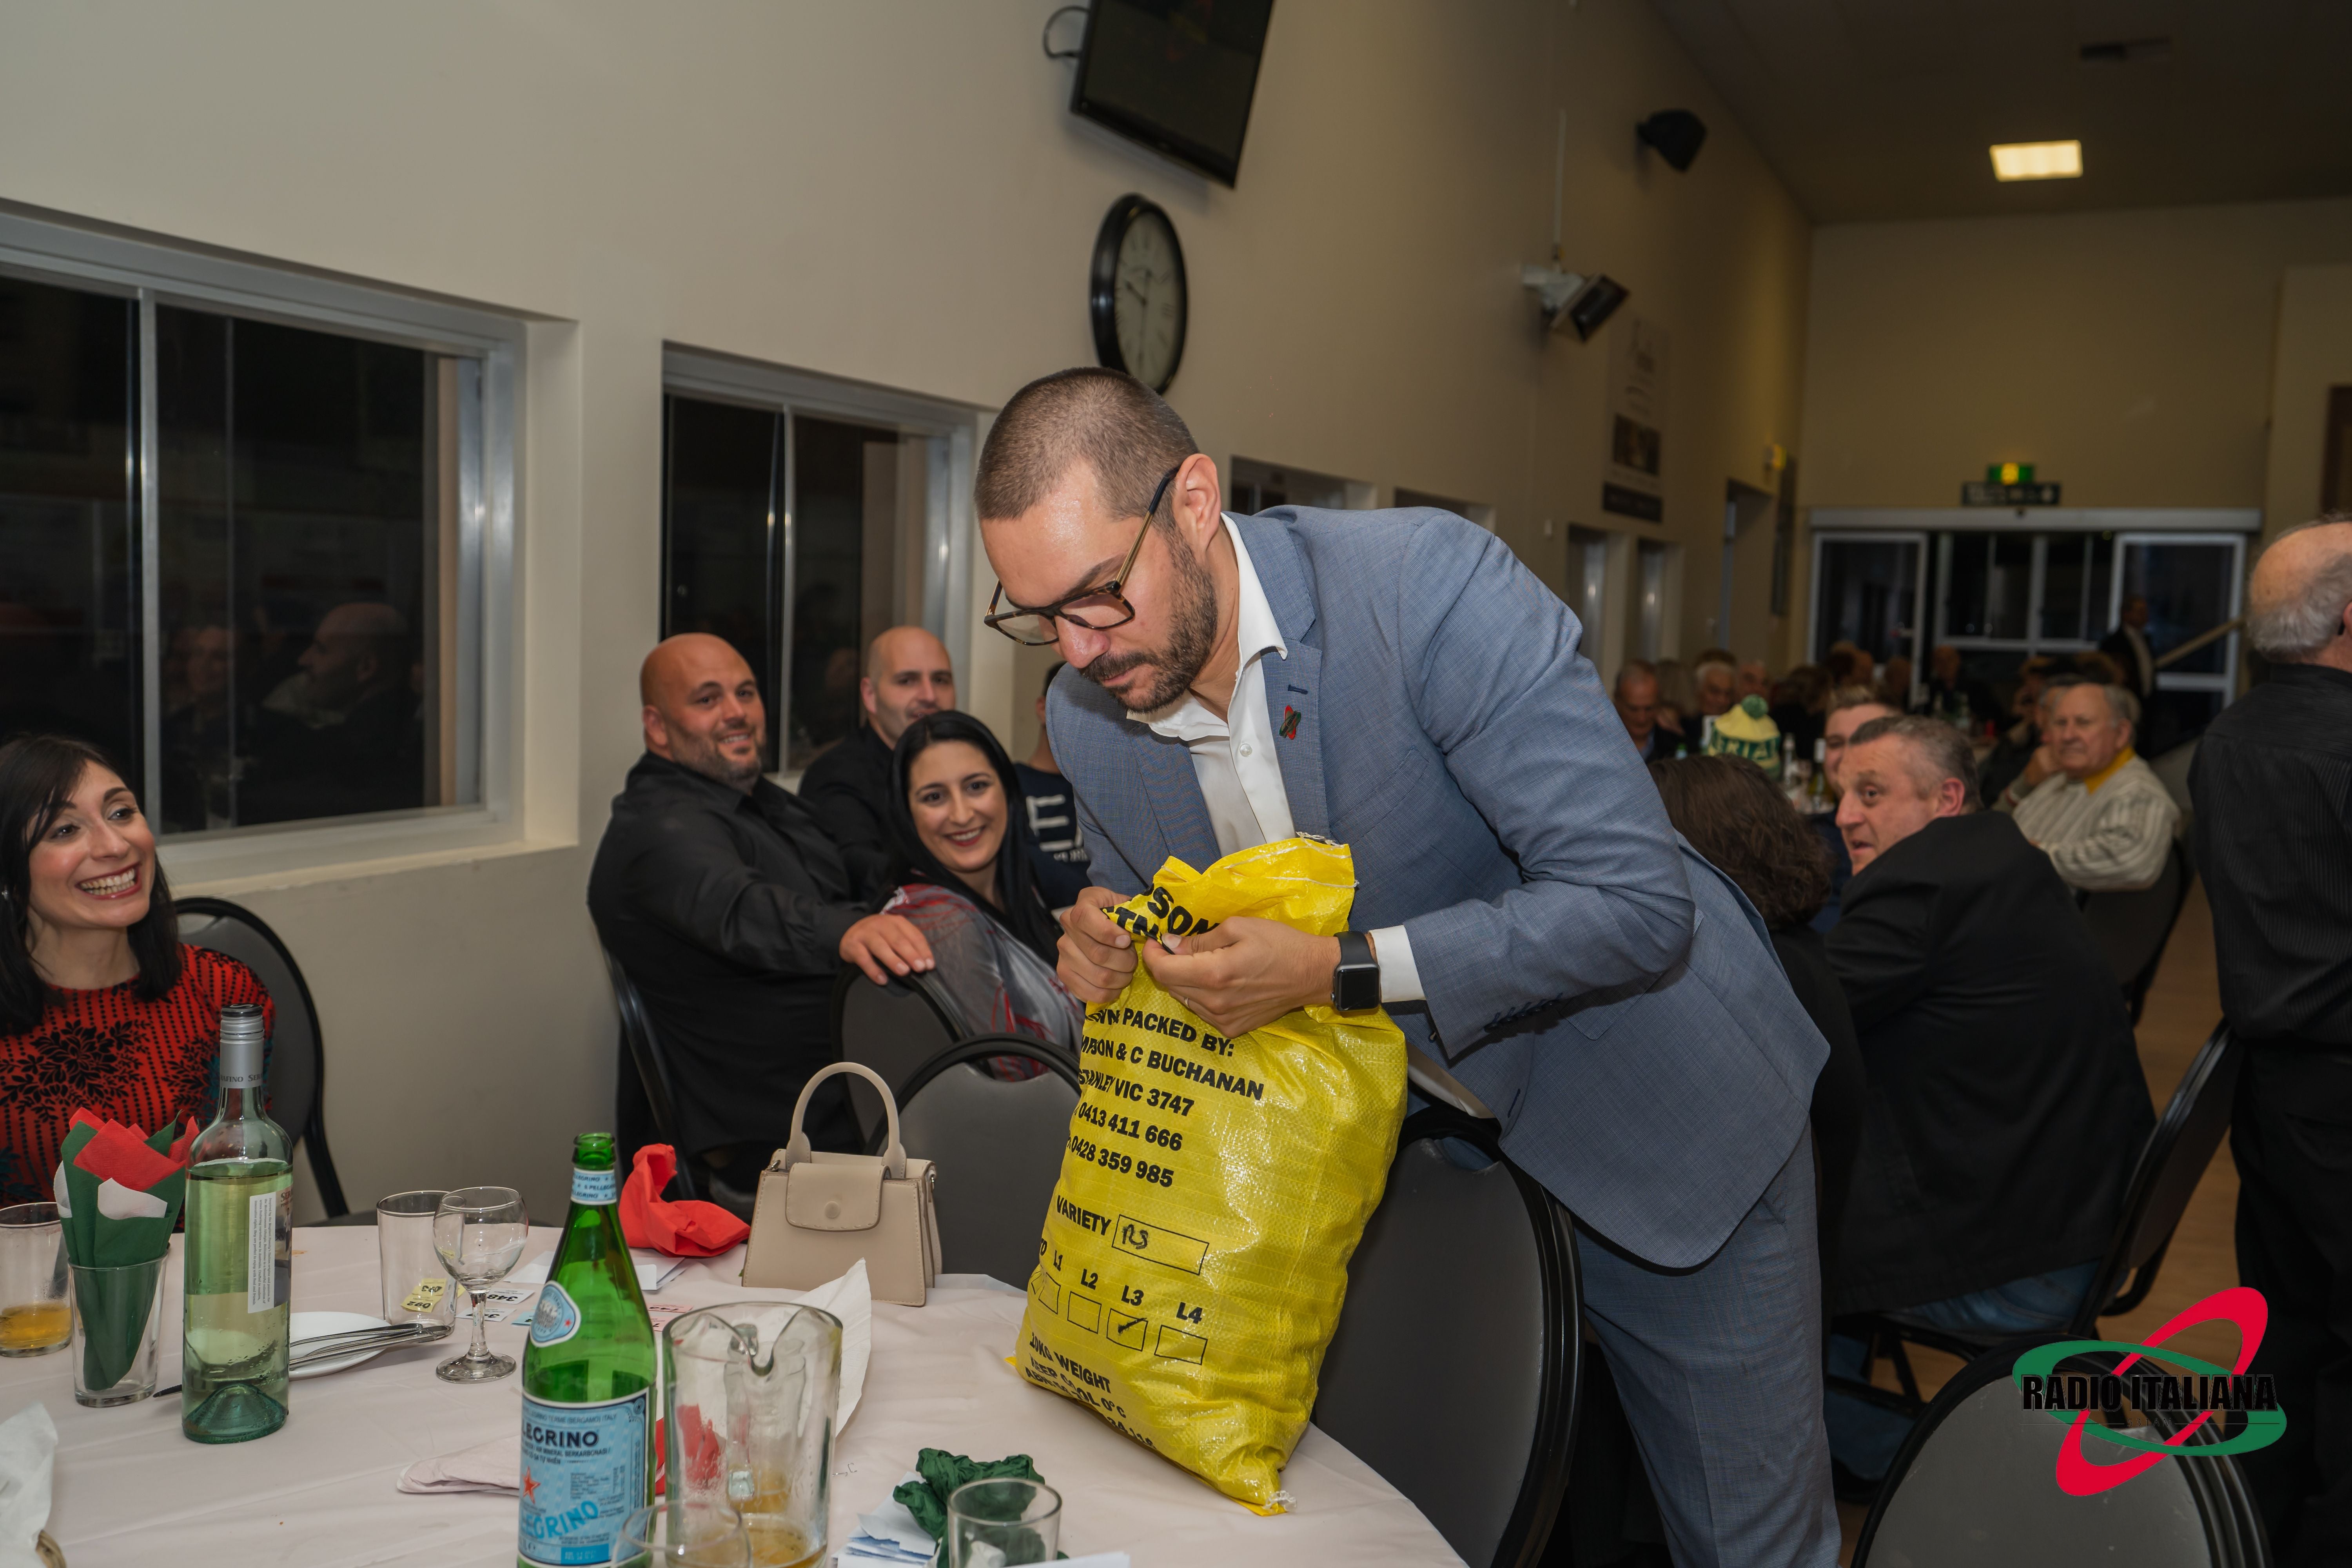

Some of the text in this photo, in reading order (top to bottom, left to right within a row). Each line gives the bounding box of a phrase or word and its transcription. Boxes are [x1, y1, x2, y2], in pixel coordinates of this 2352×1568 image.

[1122, 1008, 1197, 1042] PACKED
[1201, 1033, 1235, 1057] BY:
[1079, 1068, 1195, 1117] STANLEY VIC 3747
[1116, 1043, 1128, 1061] &
[1130, 1046, 1144, 1064] C
[1147, 1050, 1264, 1101] BUCHANAN
[1078, 1102, 1107, 1128] 0413
[1108, 1114, 1140, 1139] 411
[1145, 1125, 1183, 1151] 666
[1071, 1135, 1096, 1162] 0428
[1098, 1149, 1132, 1174] 359
[1136, 1160, 1175, 1188] 985
[1056, 1195, 1112, 1236] VARIETY
[1053, 1249, 1063, 1272] L1
[1080, 1268, 1099, 1290] L2
[1121, 1285, 1144, 1307] L3
[1176, 1301, 1203, 1325] L4
[1054, 1351, 1111, 1393] WEIGHT
